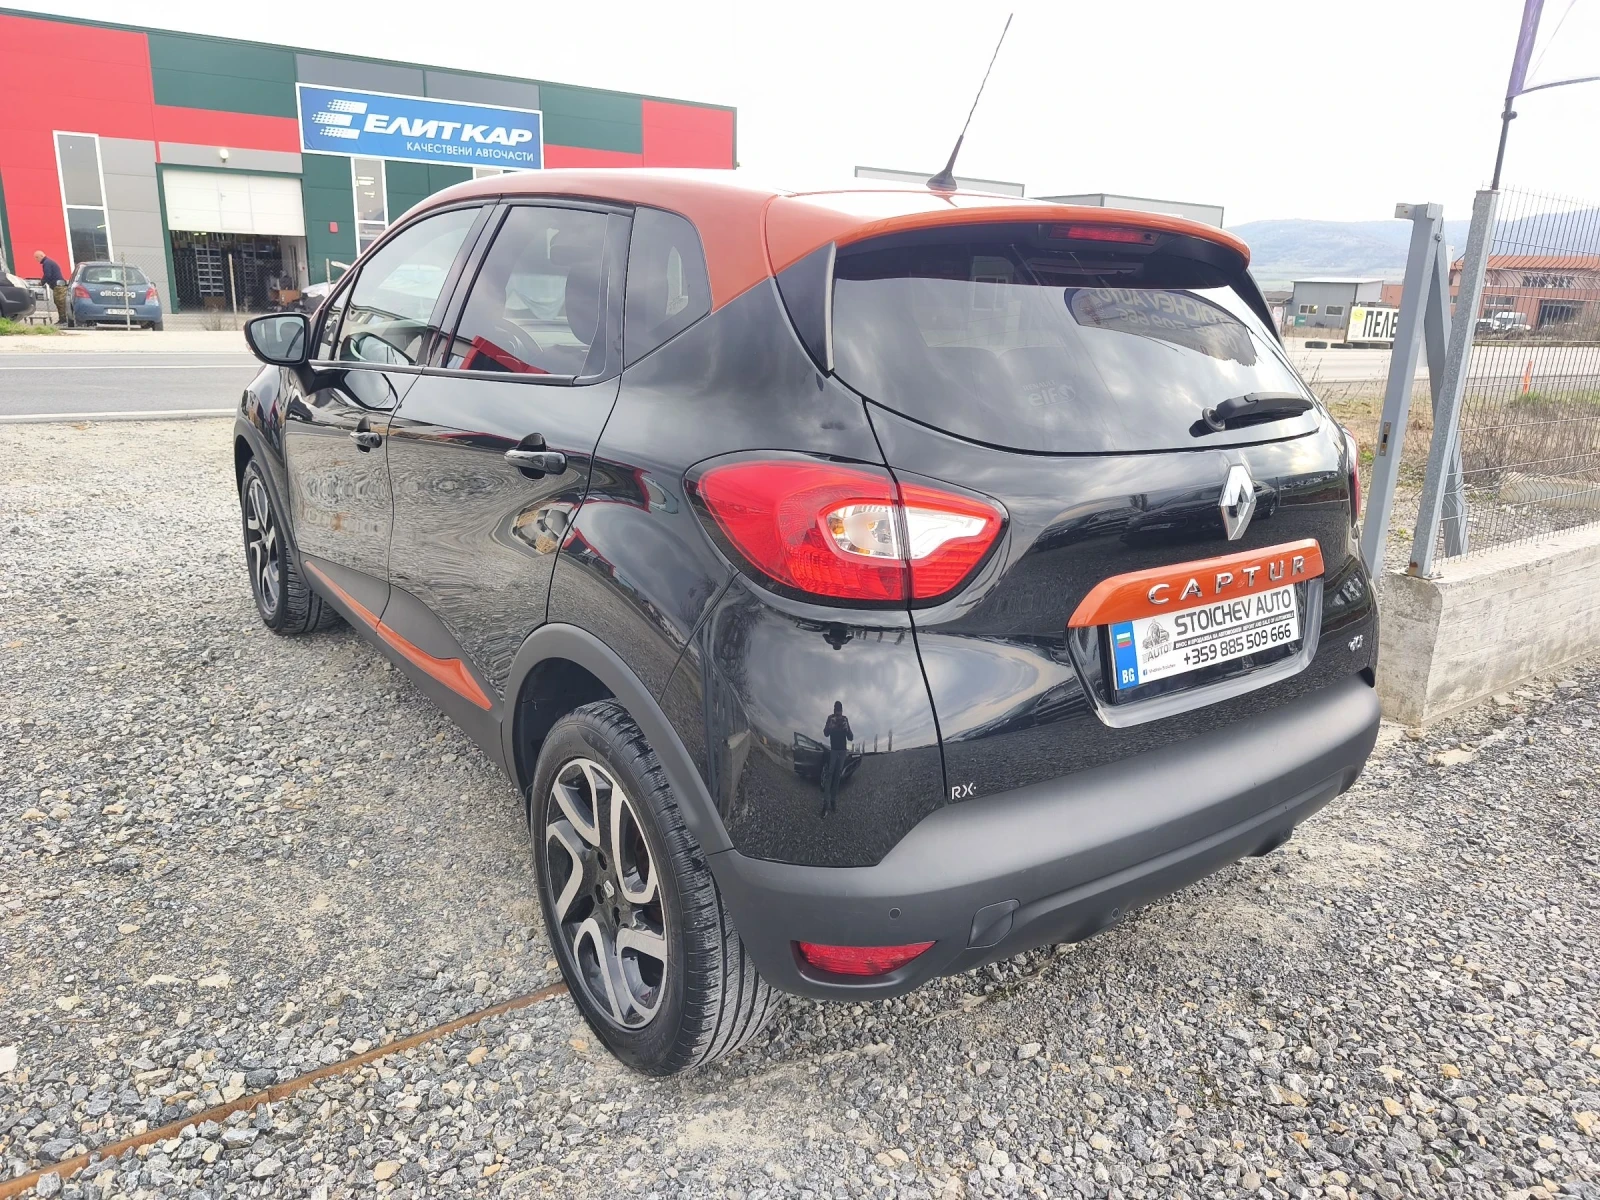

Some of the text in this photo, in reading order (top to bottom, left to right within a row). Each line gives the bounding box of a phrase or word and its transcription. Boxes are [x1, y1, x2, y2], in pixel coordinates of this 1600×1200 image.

[406, 141, 534, 162] КАЧЕСТВЕНИ АВТОЧАСТИ
[1147, 555, 1306, 605] CAPTUR
[1174, 589, 1292, 636] STOICHEV AUTO
[1147, 643, 1169, 662] AUTO
[1183, 622, 1292, 665] +359 885 509 666
[1121, 668, 1135, 684] BG
